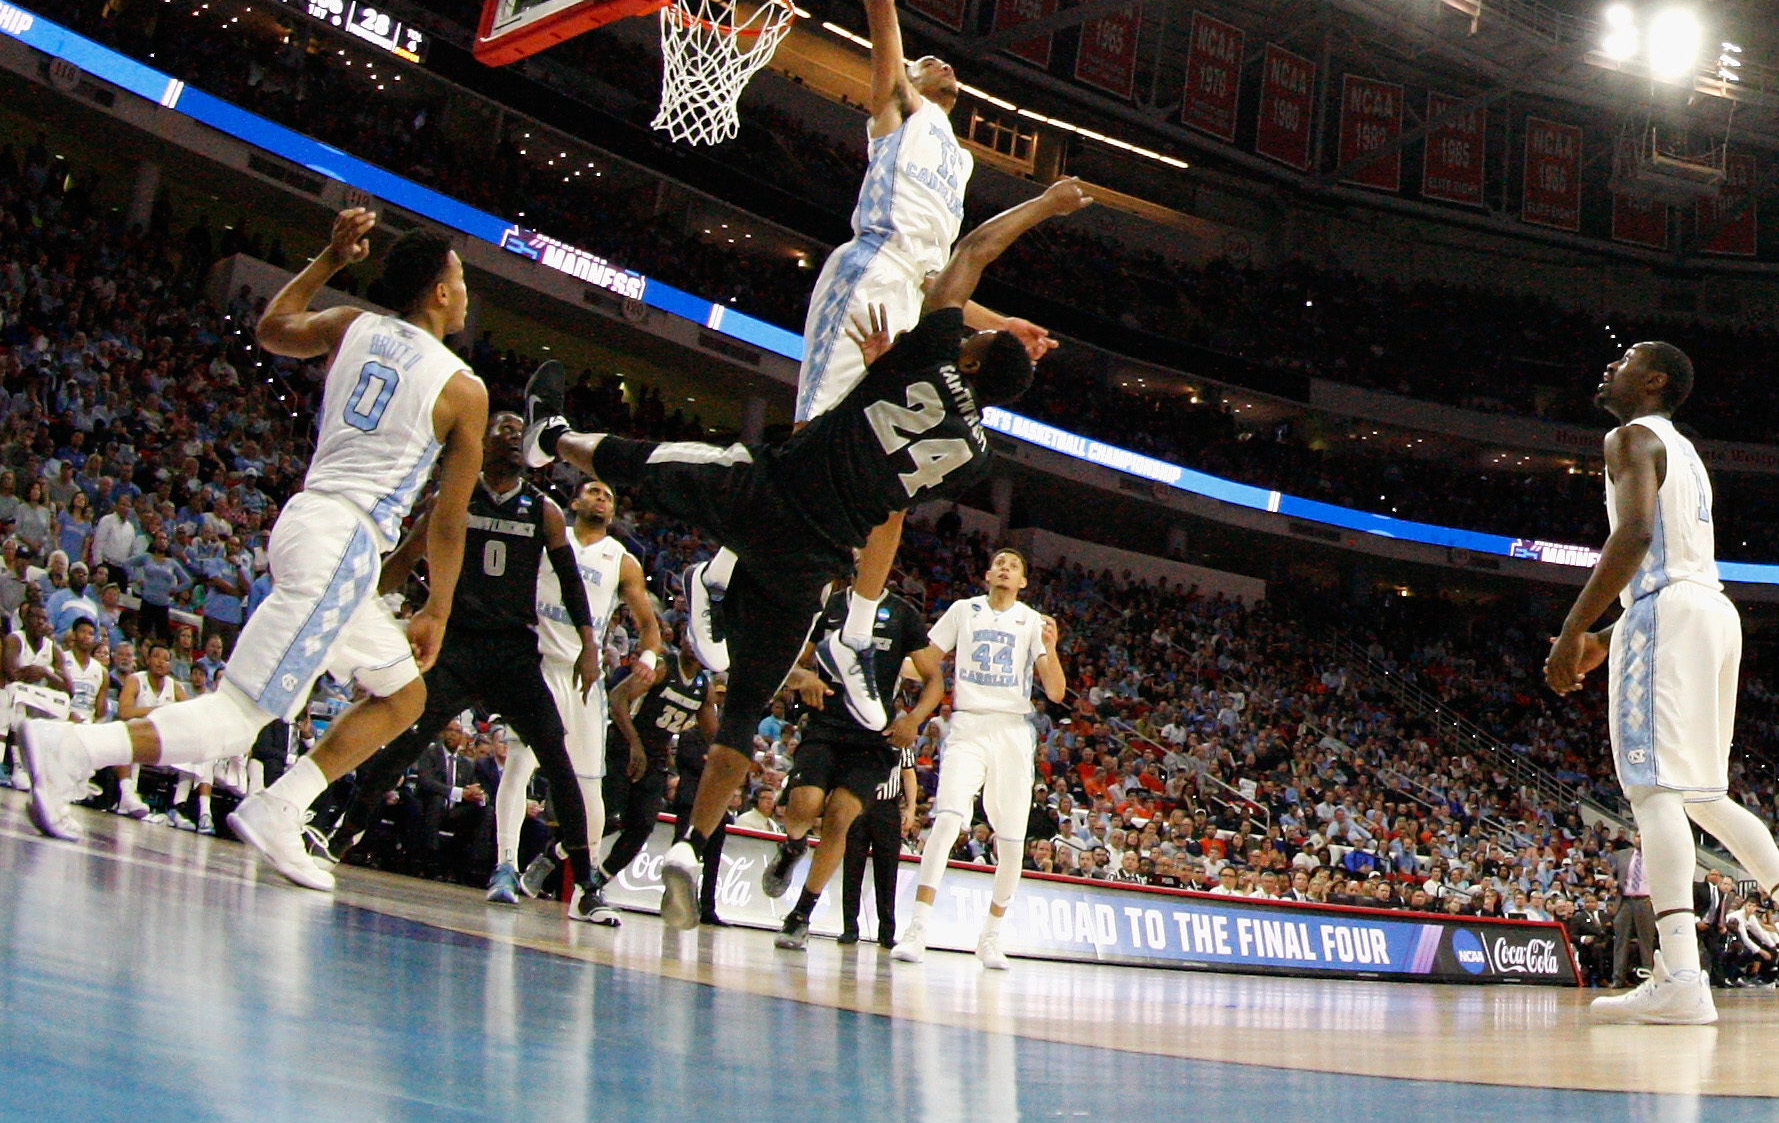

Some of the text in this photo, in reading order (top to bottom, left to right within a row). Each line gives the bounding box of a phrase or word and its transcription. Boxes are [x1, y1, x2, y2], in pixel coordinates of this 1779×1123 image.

[360, 8, 390, 36] 28
[541, 244, 641, 301] MADNESS
[342, 359, 401, 434] 0
[863, 380, 974, 498] 24
[1012, 415, 1183, 485] BASKETBALL CHAMPIONSHIP
[483, 539, 507, 577] 0
[971, 629, 1018, 648] NORTH
[958, 667, 1020, 688] CAROLINA
[971, 643, 1014, 674] 44
[655, 703, 688, 735] 32
[1026, 894, 1392, 967] ROAD TO THE FINAL FOUR
[1458, 950, 1485, 964] NCAA
[1494, 936, 1559, 974] Coca-Cola
